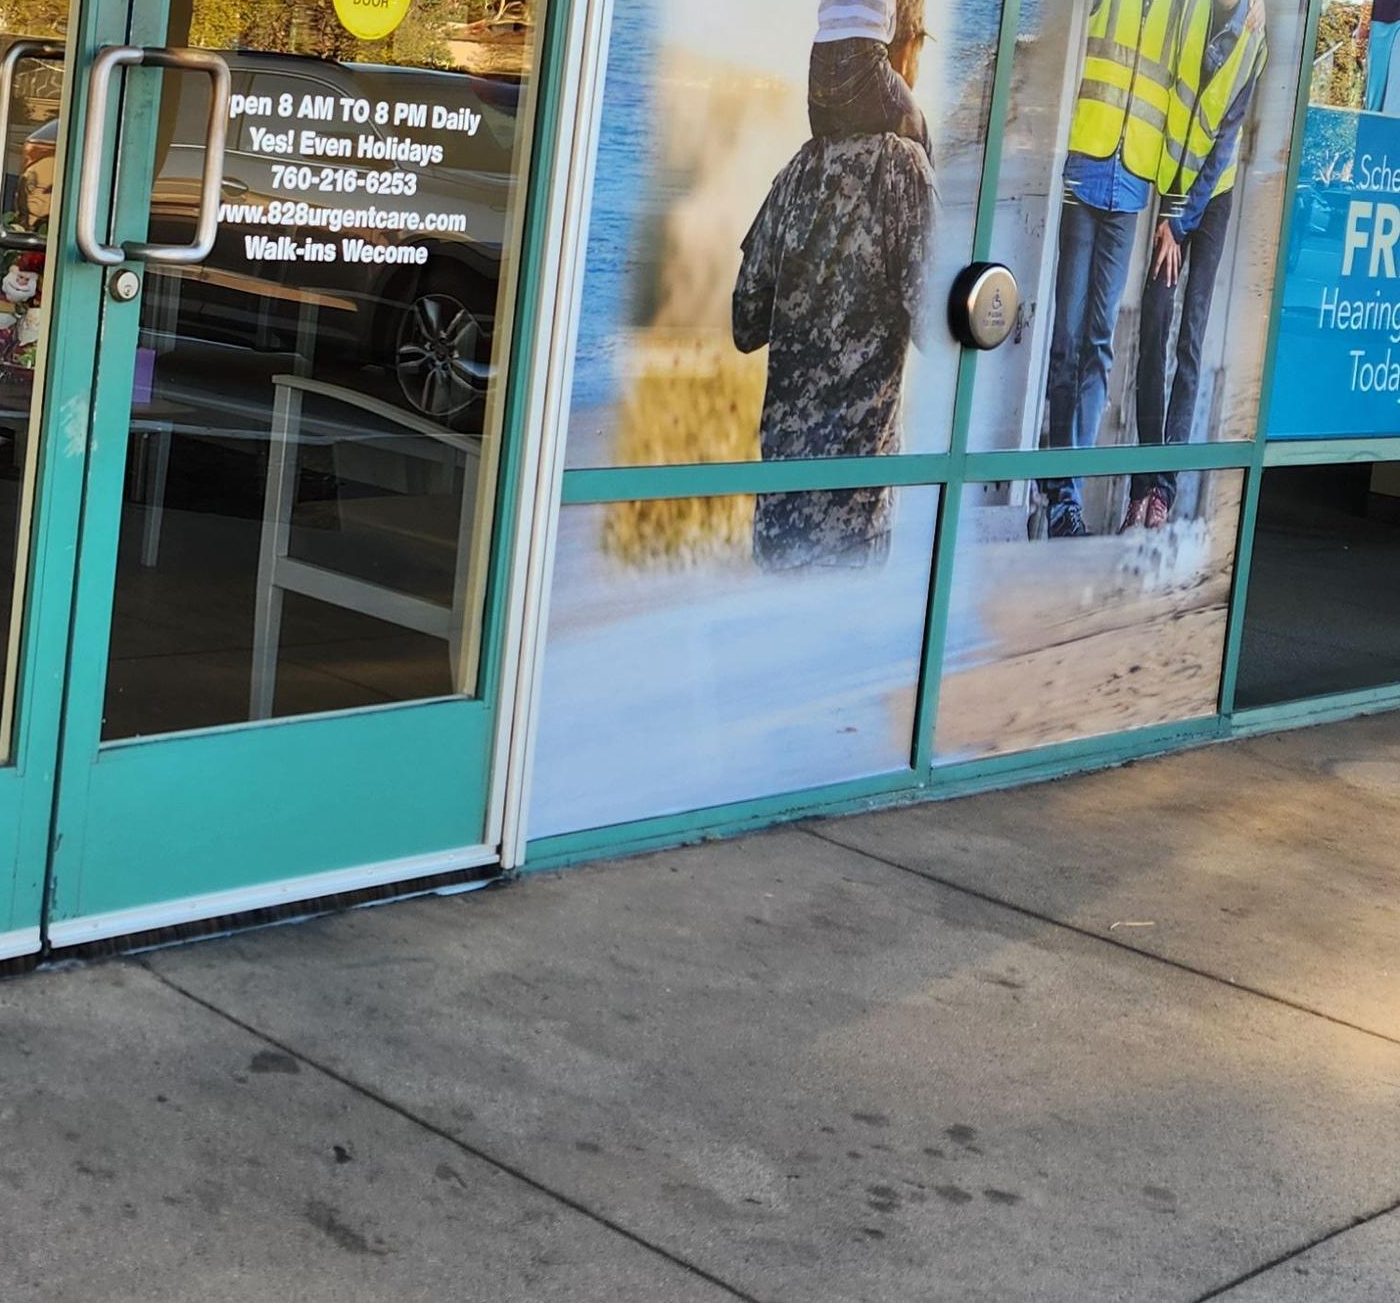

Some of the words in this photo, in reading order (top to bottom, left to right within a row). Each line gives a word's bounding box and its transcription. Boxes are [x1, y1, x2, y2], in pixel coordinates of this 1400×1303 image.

[228, 94, 272, 118] pen
[277, 93, 293, 117] 8
[298, 95, 334, 121] AM
[339, 98, 370, 123] TO
[374, 101, 389, 125] 8
[394, 103, 427, 127] PM
[432, 106, 481, 136] Daily
[249, 127, 294, 153] Yes!
[300, 130, 350, 157] Even
[357, 135, 443, 167] Holidays
[271, 165, 418, 196] 760-216-6253
[245, 235, 337, 262] Walk-ins
[342, 239, 428, 265] Wecome
[1319, 286, 1400, 343] Hearing
[1349, 347, 1400, 404] Toda
